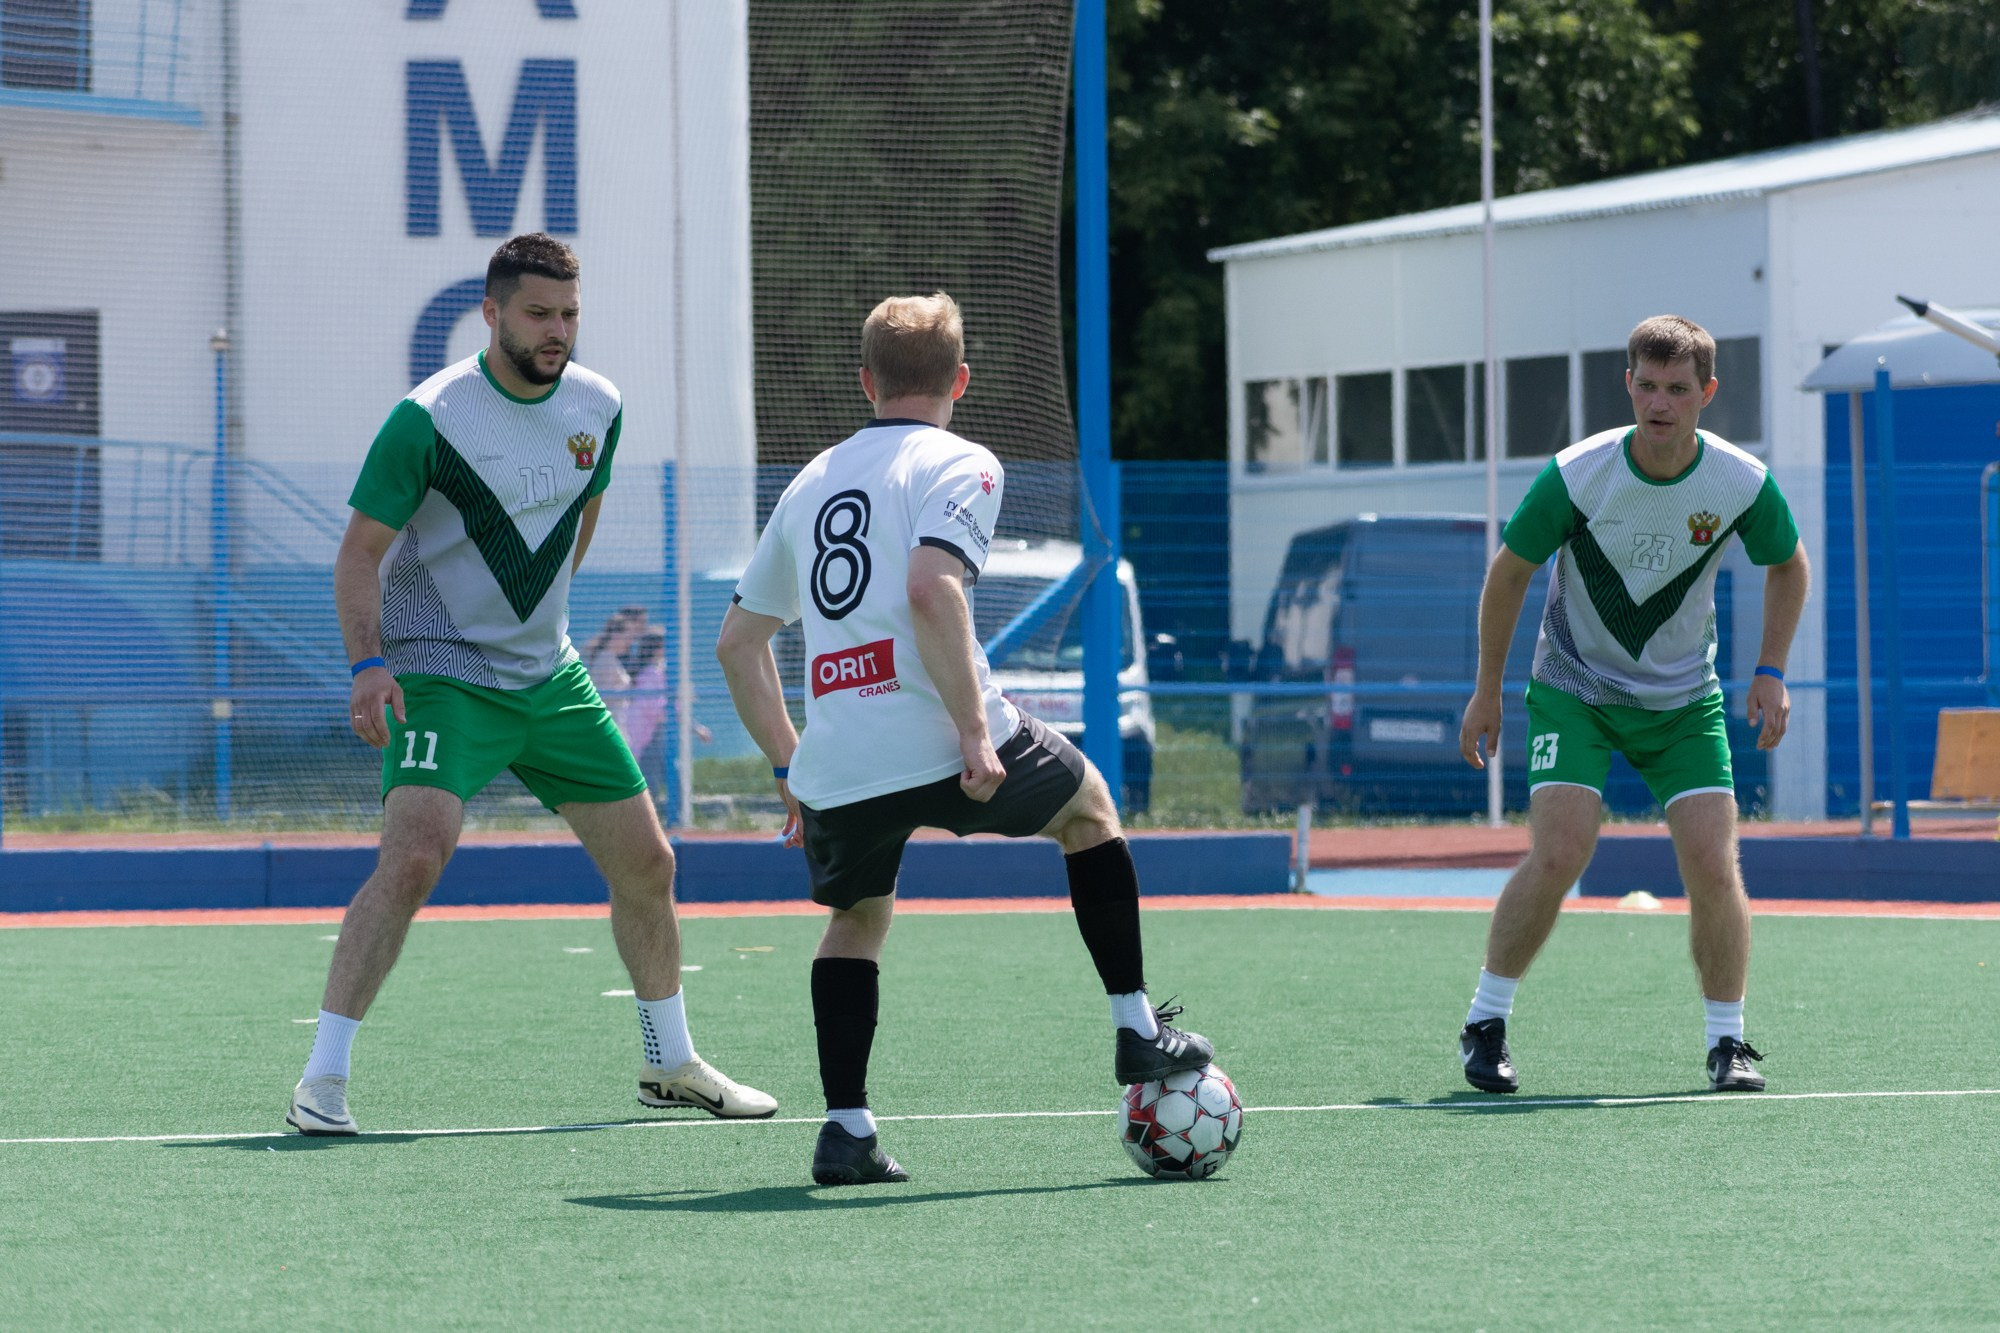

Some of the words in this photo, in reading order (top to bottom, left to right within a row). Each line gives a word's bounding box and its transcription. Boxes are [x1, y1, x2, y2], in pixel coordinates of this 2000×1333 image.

[519, 466, 559, 510] 11
[946, 500, 959, 511] ГУ
[959, 506, 974, 523] МЧС
[810, 488, 872, 621] 8
[1630, 533, 1675, 572] 23
[819, 651, 879, 685] ORIT
[858, 680, 901, 698] CRANES
[400, 730, 438, 770] 11
[1531, 732, 1560, 772] 23
